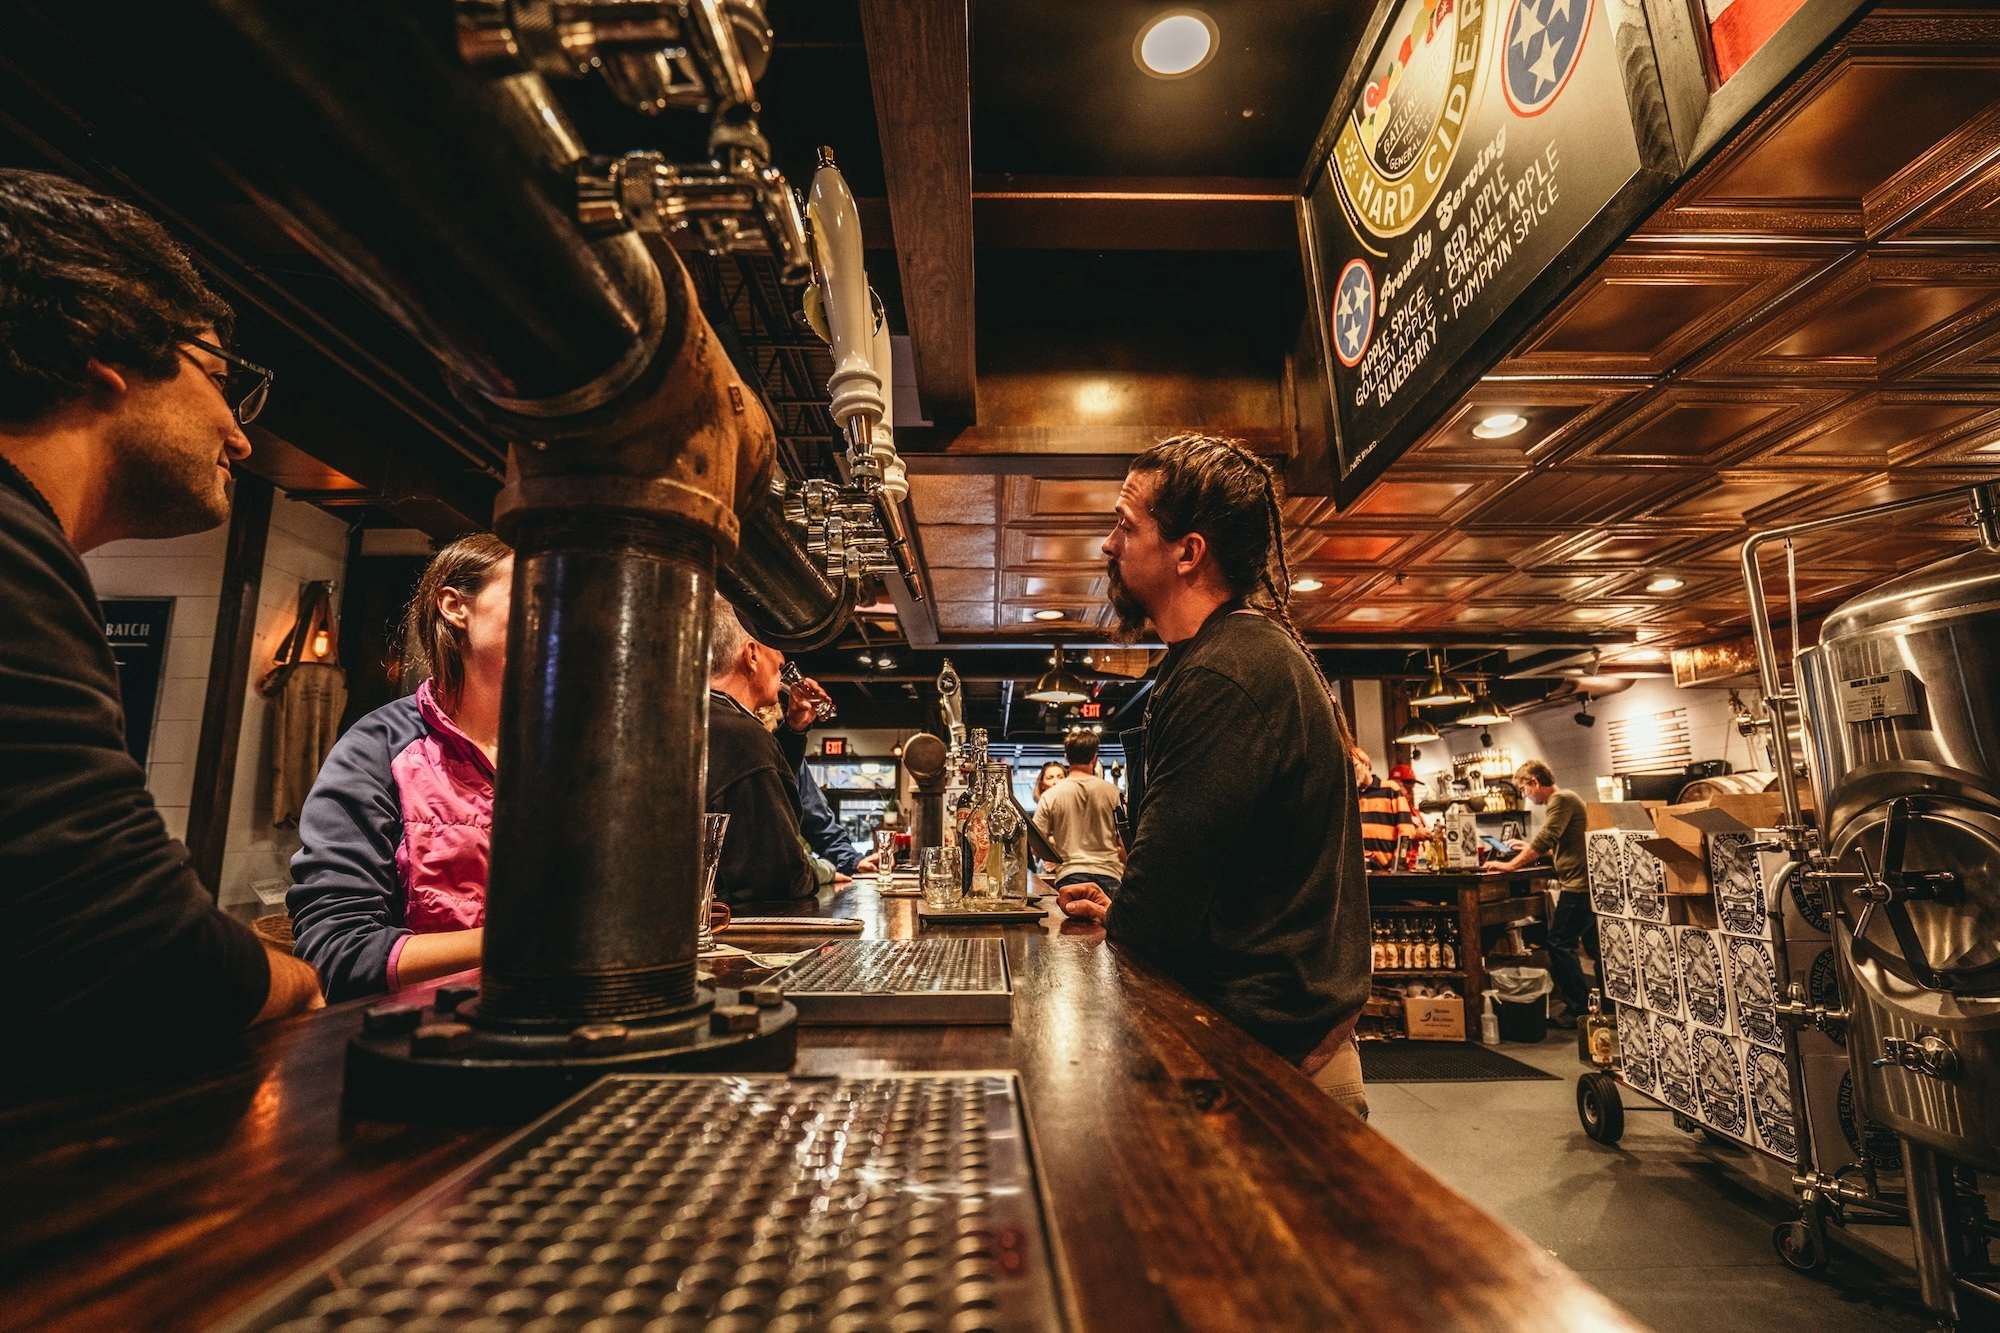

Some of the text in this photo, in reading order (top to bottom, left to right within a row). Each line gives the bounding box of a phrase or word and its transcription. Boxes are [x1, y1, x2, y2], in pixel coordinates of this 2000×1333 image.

[1358, 170, 1415, 227] HARD
[1424, 0, 1482, 184] CIDER
[1389, 138, 1422, 170] GENERAL
[1402, 127, 1414, 145] THE
[1379, 124, 1507, 317] Proudly Serving
[1443, 161, 1510, 269] RED APPLE
[1447, 138, 1560, 290] CARAMEL APPLE
[1452, 174, 1560, 320] PUMPKIN SPICE
[1355, 348, 1396, 407] GOLDEN
[1398, 296, 1436, 356] APPLE
[1361, 284, 1426, 380] APPLE SPICE
[1376, 316, 1439, 408] BLUEBERRY
[105, 623, 151, 637] BATCH
[825, 740, 843, 755] EXIT
[1083, 703, 1101, 718] EXIT
[1811, 951, 1834, 1003] TENNESS
